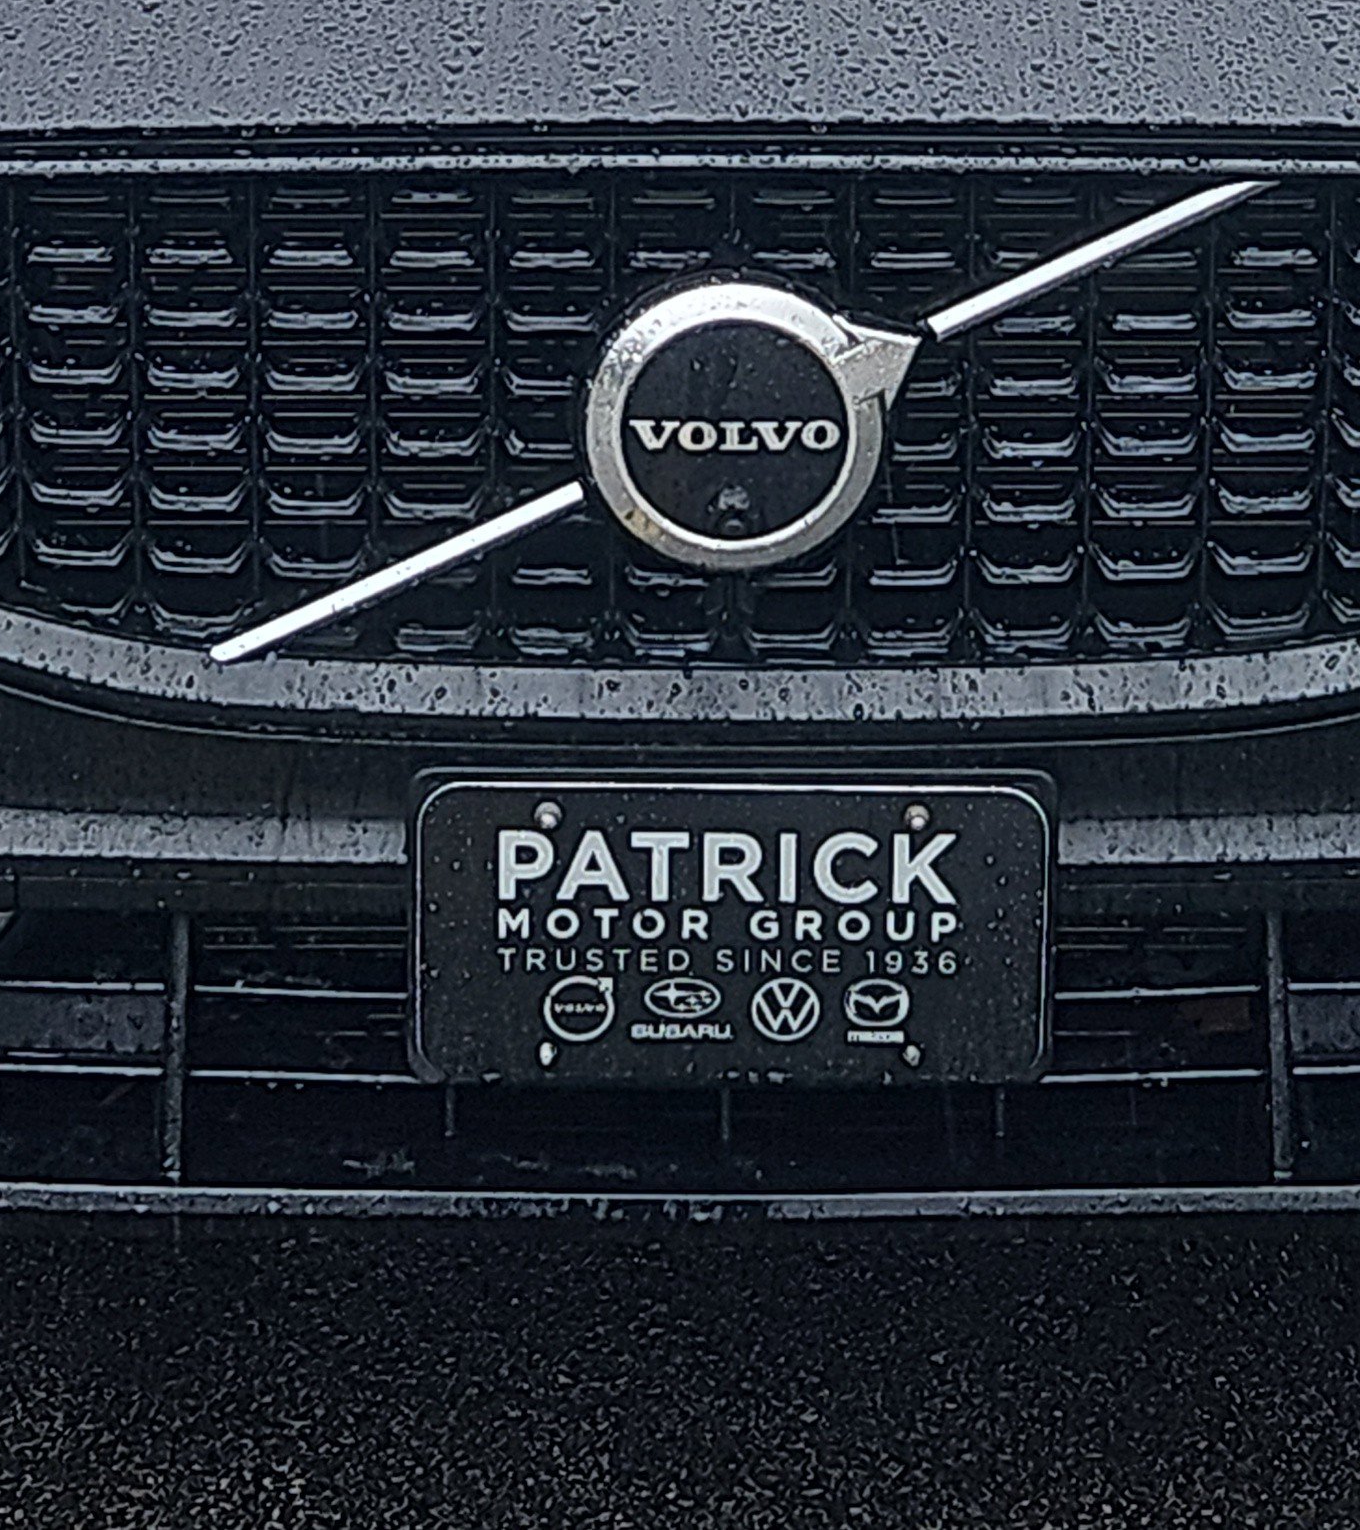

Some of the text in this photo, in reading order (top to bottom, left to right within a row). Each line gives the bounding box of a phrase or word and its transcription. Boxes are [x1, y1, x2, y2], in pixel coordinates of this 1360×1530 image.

[628, 419, 841, 451] VOLVO
[497, 830, 958, 905] PATRICK
[498, 908, 957, 942] MOTOR GROUP
[497, 947, 957, 975] TRUSTED SINCE 1936
[630, 1023, 733, 1039] SUBARU
